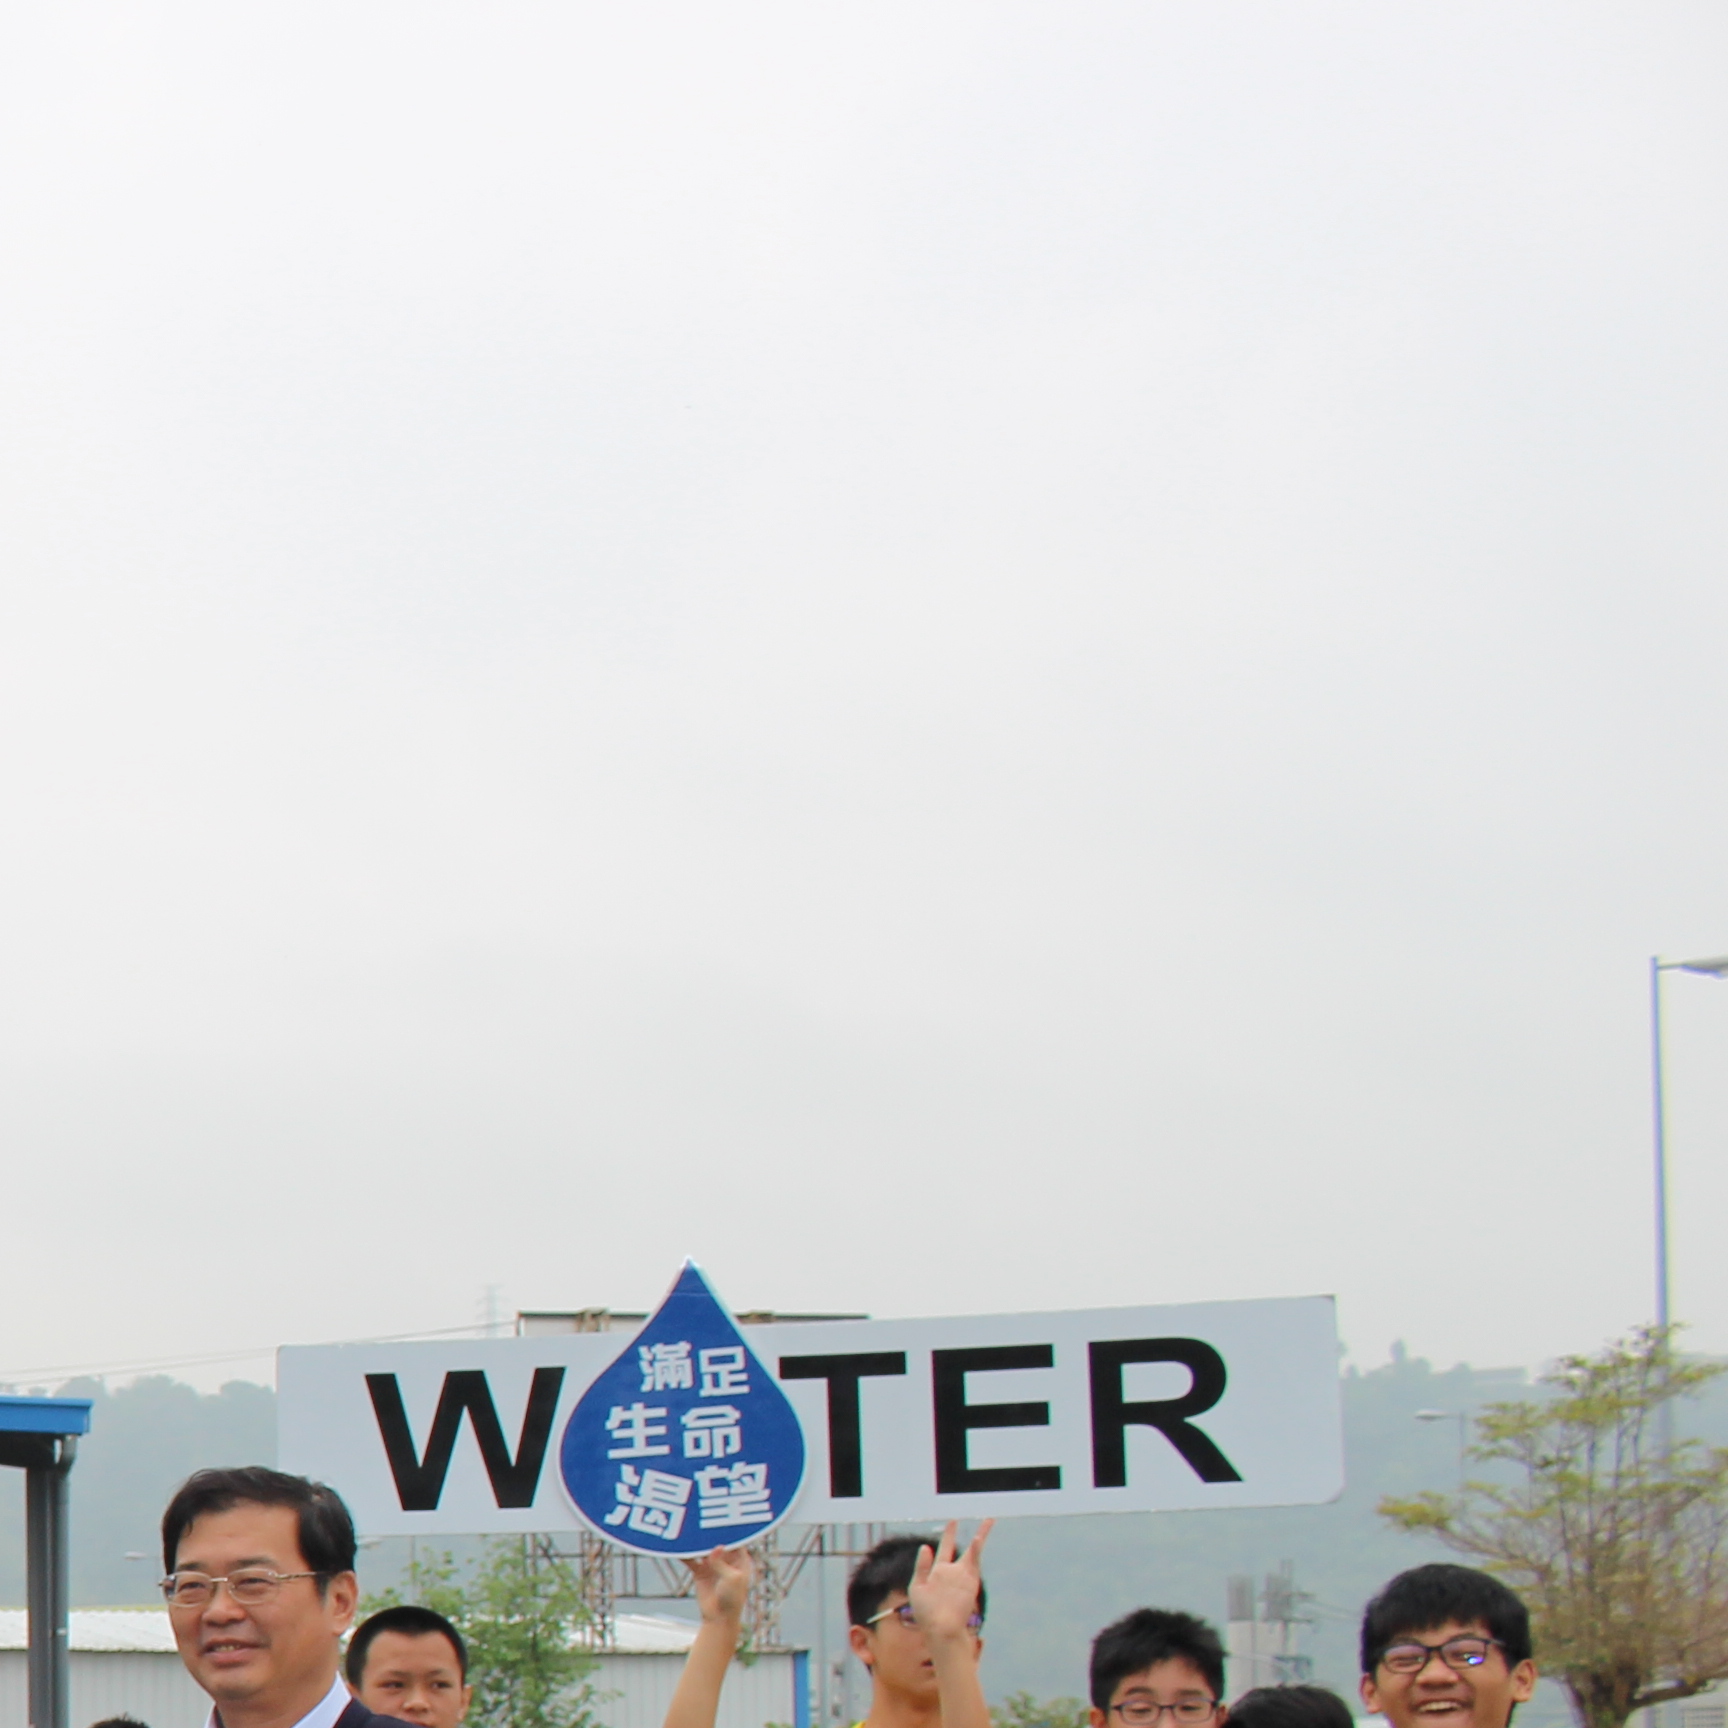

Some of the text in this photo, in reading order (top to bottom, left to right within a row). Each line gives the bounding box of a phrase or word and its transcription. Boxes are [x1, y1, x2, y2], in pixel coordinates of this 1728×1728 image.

[638, 1340, 751, 1398] 滿足
[605, 1402, 742, 1460] 生命
[604, 1462, 774, 1540] 渴望
